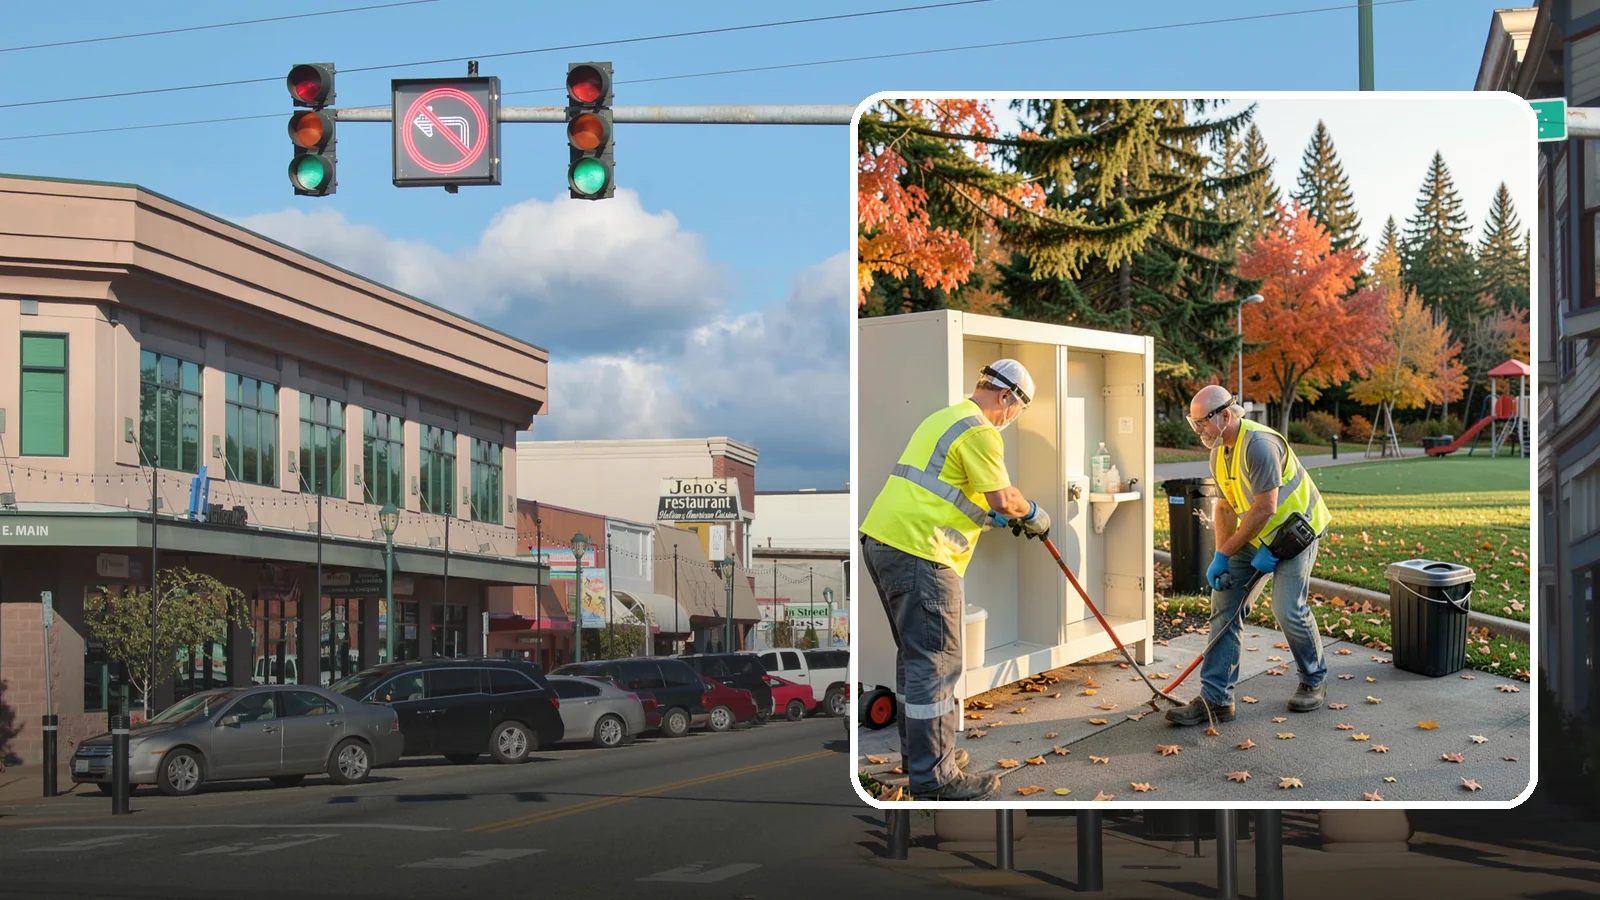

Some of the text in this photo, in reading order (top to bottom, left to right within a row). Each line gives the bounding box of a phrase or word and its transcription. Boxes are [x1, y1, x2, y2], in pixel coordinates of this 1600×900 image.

[669, 480, 727, 494] Jeno's
[665, 496, 731, 509] restaurant
[686, 510, 714, 519] American
[715, 510, 737, 519] Cuisine
[2, 525, 49, 536] E. MAIN
[797, 608, 829, 617] Street
